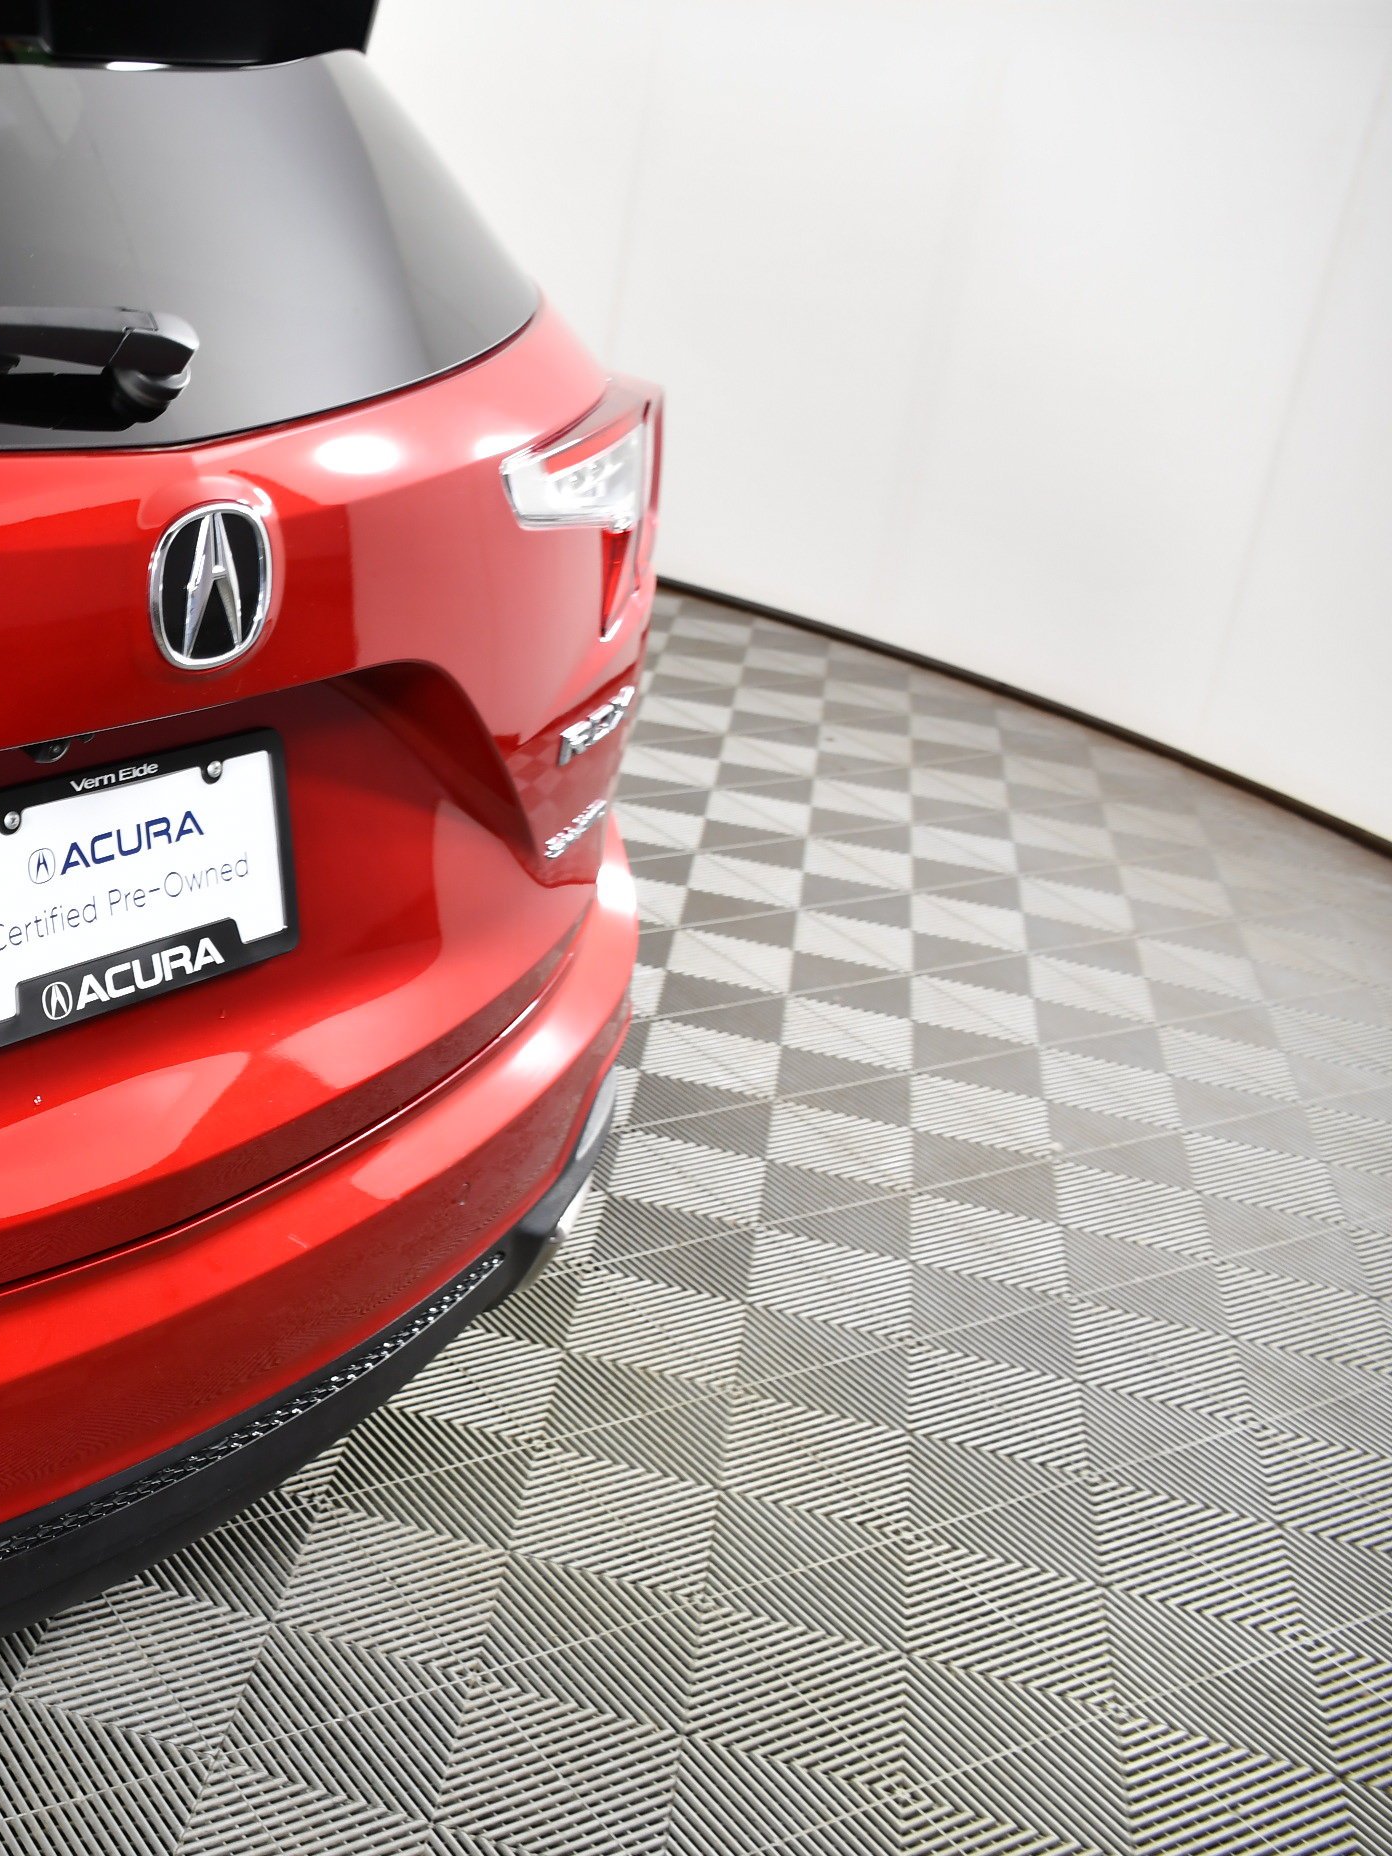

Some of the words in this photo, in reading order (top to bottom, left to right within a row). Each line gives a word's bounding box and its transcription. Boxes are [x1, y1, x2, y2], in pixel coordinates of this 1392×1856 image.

[70, 773, 116, 792] Vern
[119, 763, 159, 781] Eide
[60, 811, 205, 875] ACURA
[108, 852, 250, 917] Pre-Owned
[76, 937, 225, 1010] ACURA
